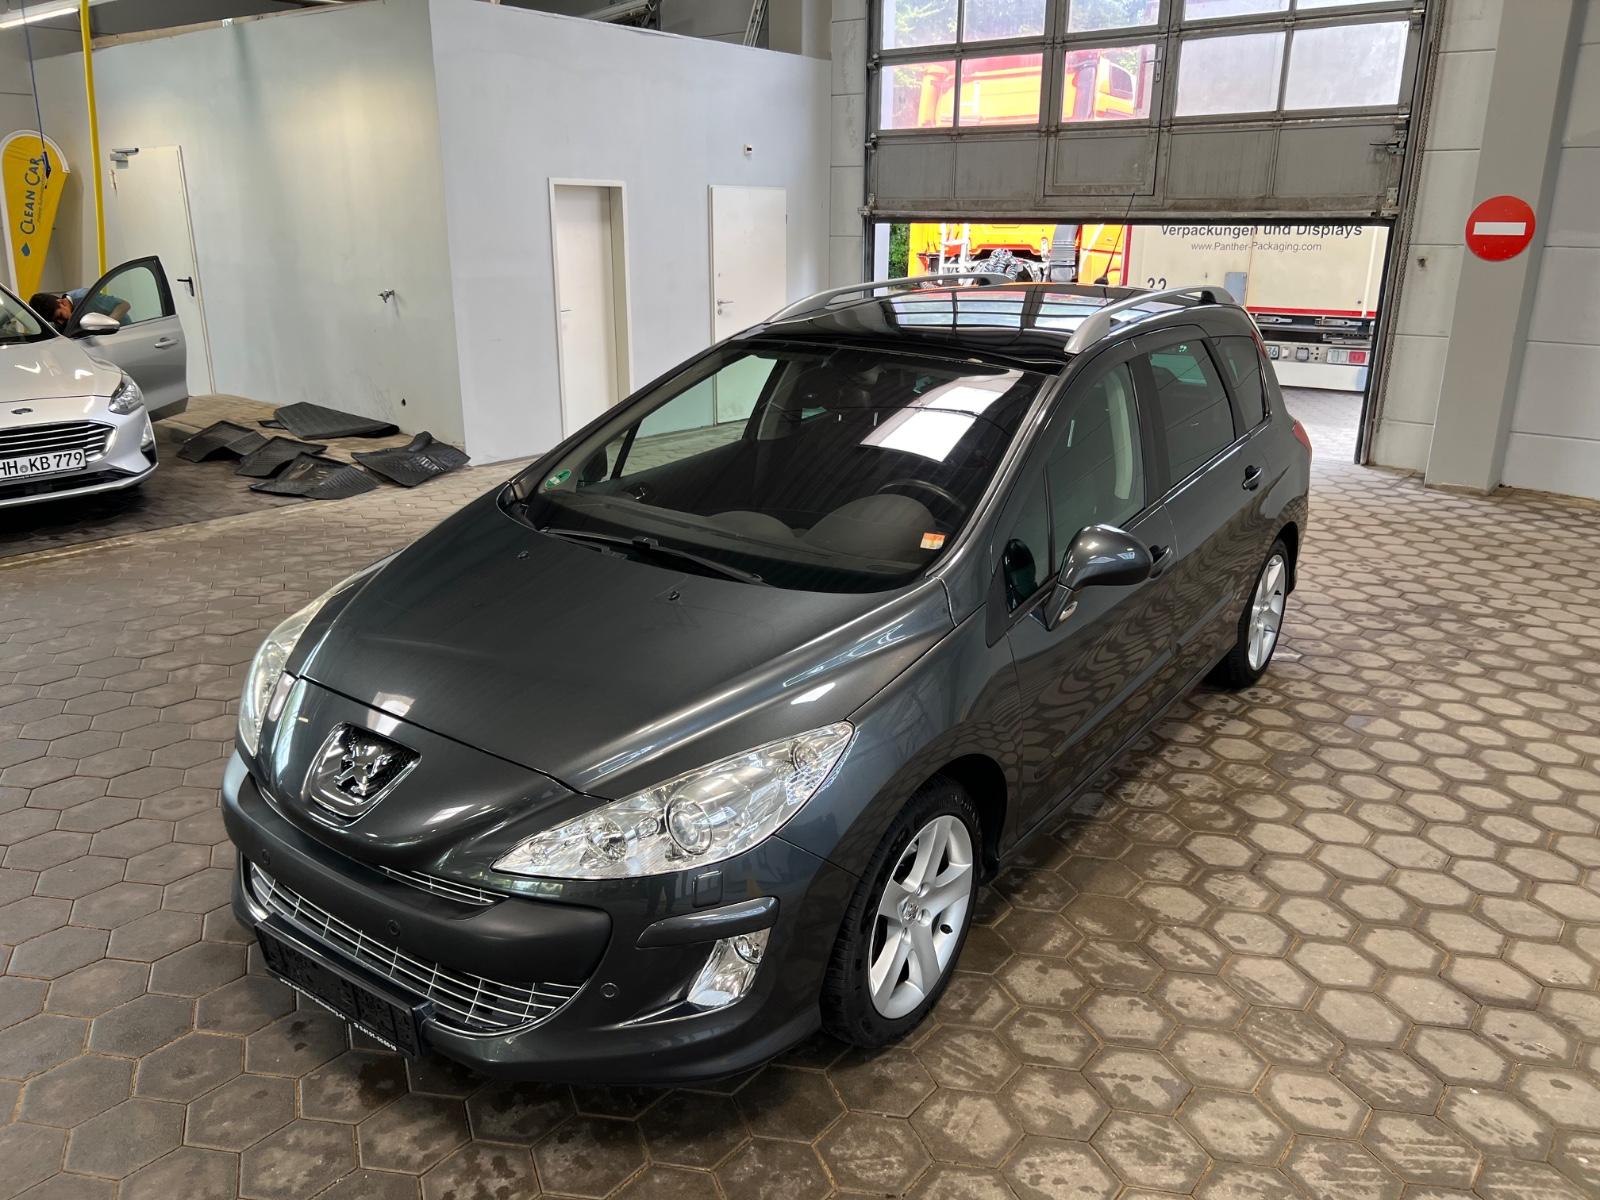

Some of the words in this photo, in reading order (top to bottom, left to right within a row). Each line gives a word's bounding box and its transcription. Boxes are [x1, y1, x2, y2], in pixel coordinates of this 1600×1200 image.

[25, 158, 42, 186] CAR
[20, 190, 36, 235] CLEAN
[1161, 224, 1259, 239] Verpackungen
[1264, 224, 1291, 235] und
[1296, 224, 1362, 239] Displays
[1191, 241, 1322, 254] www.Panther-Packaging.com
[29, 456, 51, 472] KB
[53, 451, 83, 468] 779
